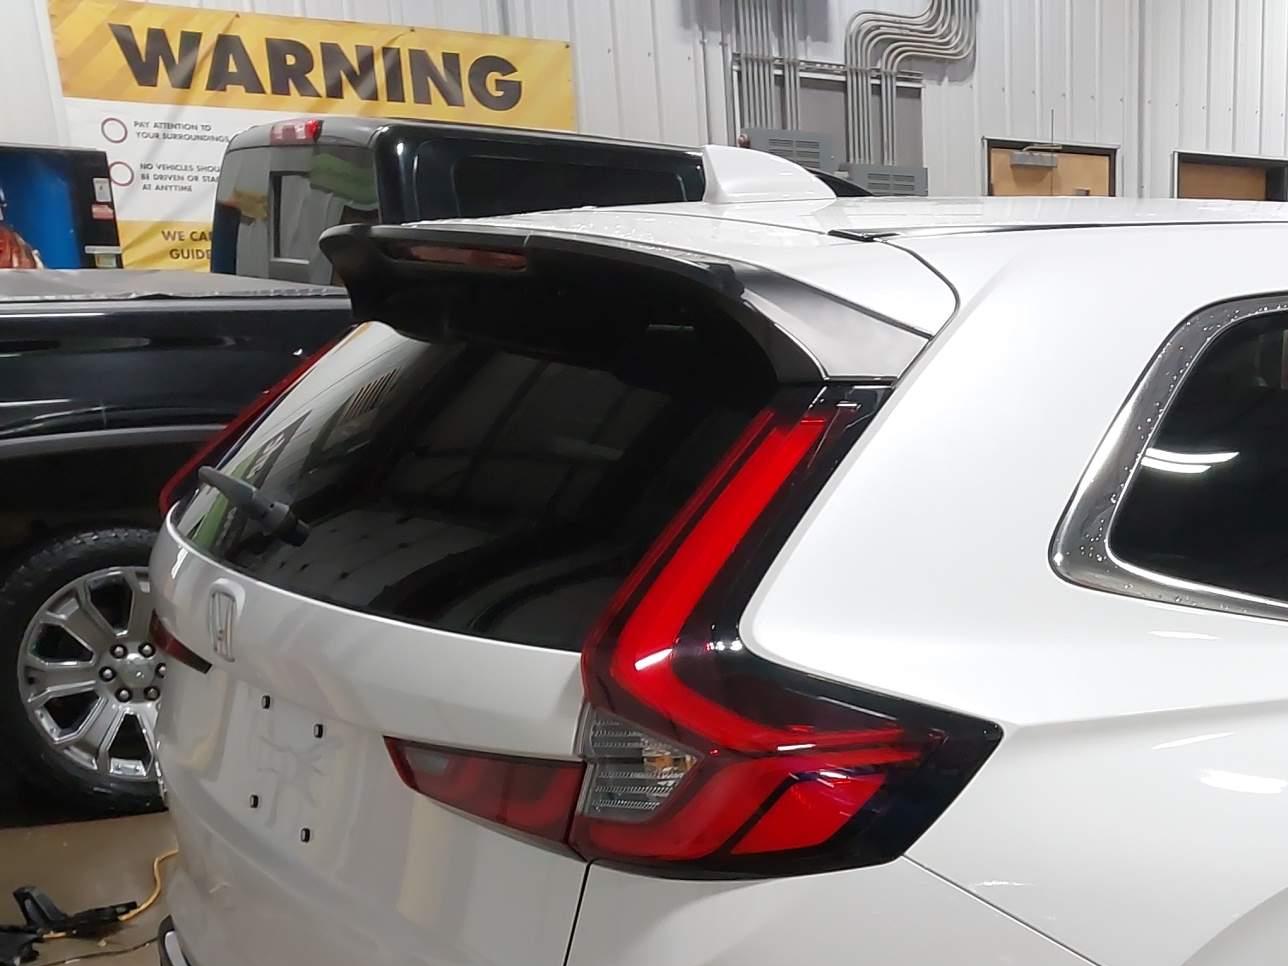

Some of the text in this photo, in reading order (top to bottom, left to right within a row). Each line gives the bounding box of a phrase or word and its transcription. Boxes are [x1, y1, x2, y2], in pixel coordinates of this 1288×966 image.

[108, 23, 522, 111] WARNING
[133, 121, 212, 132] PAY ATTENTION TO
[136, 131, 229, 142] YOUR SURROUNDINGS
[156, 163, 194, 172] VEHICLES
[196, 165, 220, 173] SHOU
[155, 184, 192, 192] ANYTIME
[161, 230, 185, 241] WE
